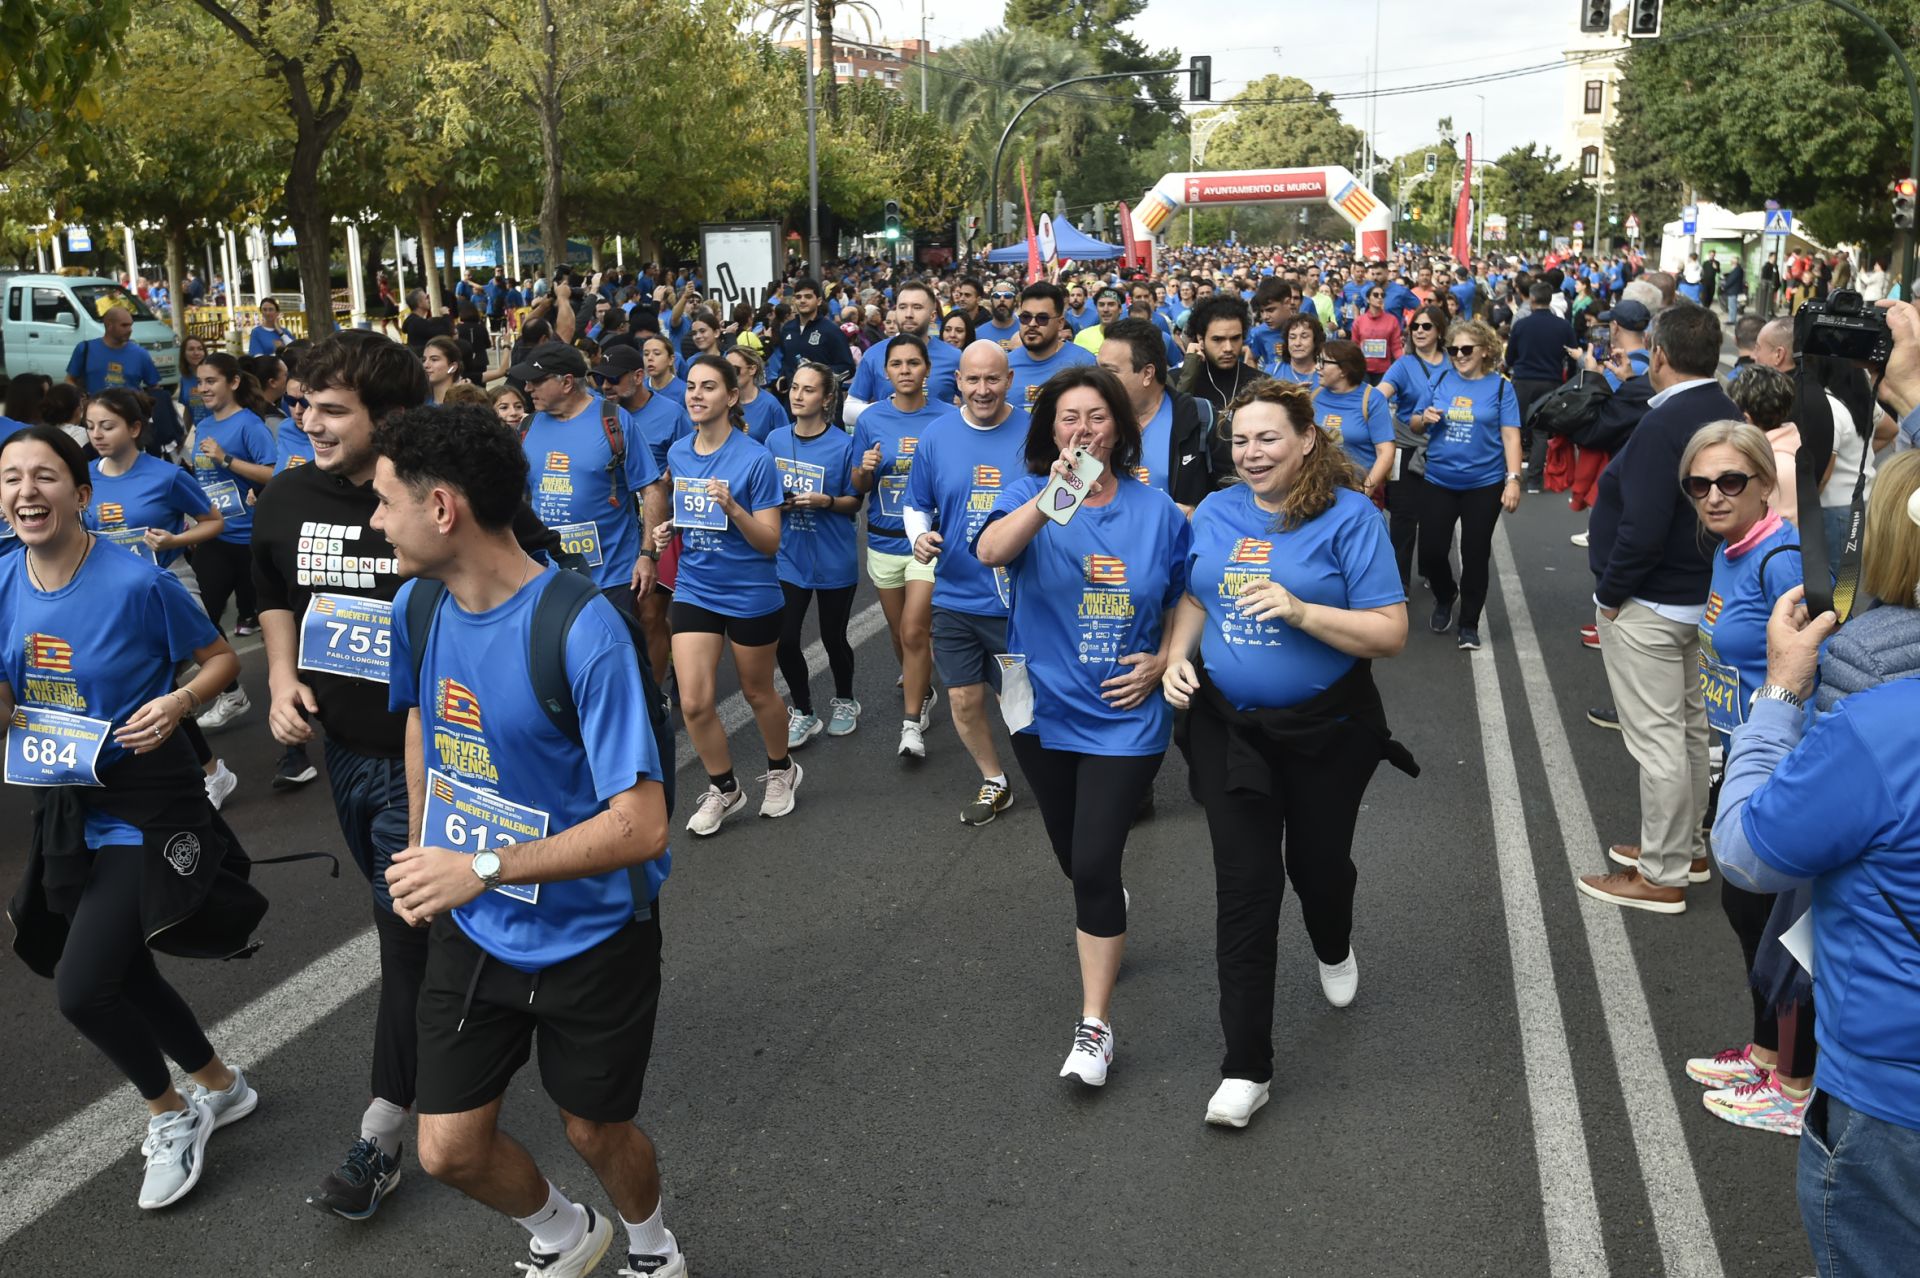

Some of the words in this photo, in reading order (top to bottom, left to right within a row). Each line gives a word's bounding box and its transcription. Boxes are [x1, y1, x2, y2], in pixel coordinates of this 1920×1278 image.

[1203, 184, 1270, 195] AYUNTAMIENTO
[1273, 183, 1285, 192] DE
[1287, 182, 1322, 192] MURCIA
[783, 473, 814, 492] 845
[684, 495, 718, 513] 597
[890, 490, 905, 503] 7
[1850, 511, 1860, 539] Nikon
[300, 539, 340, 552] ODS
[300, 556, 399, 570] ESIONE
[299, 574, 340, 583] UMU
[1083, 591, 1130, 605] MUÉVETE
[1078, 604, 1084, 616] X
[1087, 604, 1135, 617] VALENCIA
[325, 621, 391, 658] 755
[326, 650, 350, 661] PABLO
[351, 654, 390, 668] LONGINOS
[26, 679, 79, 696] MUÉVETE
[33, 688, 87, 708] VALENCIA
[22, 735, 77, 769] 684
[41, 767, 54, 775] ANA
[456, 799, 491, 821] MUÉVETE
[491, 814, 499, 825] X
[499, 815, 540, 838] VALENCIA
